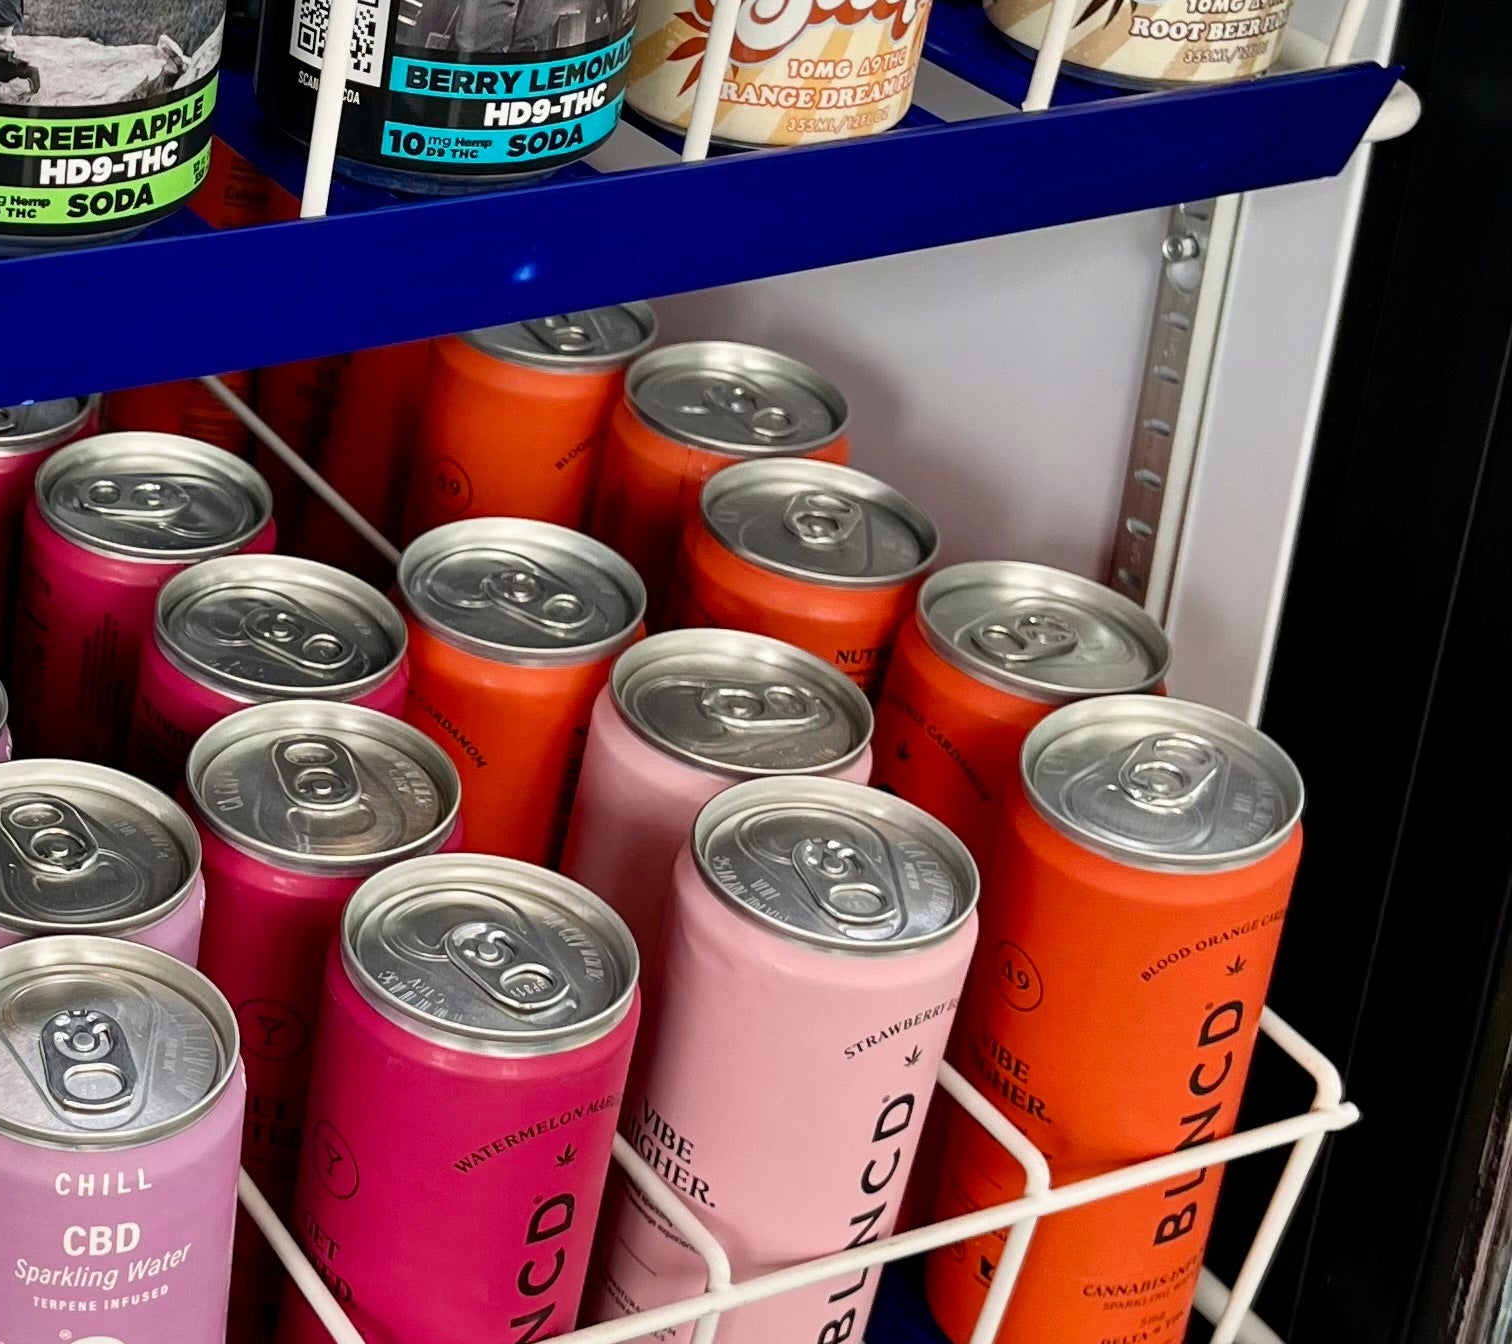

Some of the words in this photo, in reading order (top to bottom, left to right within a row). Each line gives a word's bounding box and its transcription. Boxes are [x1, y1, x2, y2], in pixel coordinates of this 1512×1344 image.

[1130, 15, 1206, 40] ROOT
[1207, 15, 1262, 41] BEER
[405, 63, 525, 94] BERRY
[788, 58, 850, 79] 10MG
[126, 95, 205, 145] APPLE
[483, 82, 607, 128] HD9-THC
[388, 129, 426, 156] 10
[505, 124, 584, 158] SODA
[39, 141, 179, 185] HD9-THC
[66, 183, 154, 219] SODA
[1140, 947, 1192, 983] BLOOD
[1194, 920, 1259, 952] ORANGE
[452, 1107, 584, 1175] WATERMELON
[642, 1095, 695, 1164] VIBE
[54, 1168, 152, 1197] CHILL
[62, 1221, 141, 1257] CBD
[14, 1258, 119, 1292] Sparkling
[127, 1241, 192, 1283] Water
[32, 1295, 97, 1312] TERPENE
[103, 1284, 169, 1310] INFUSED
